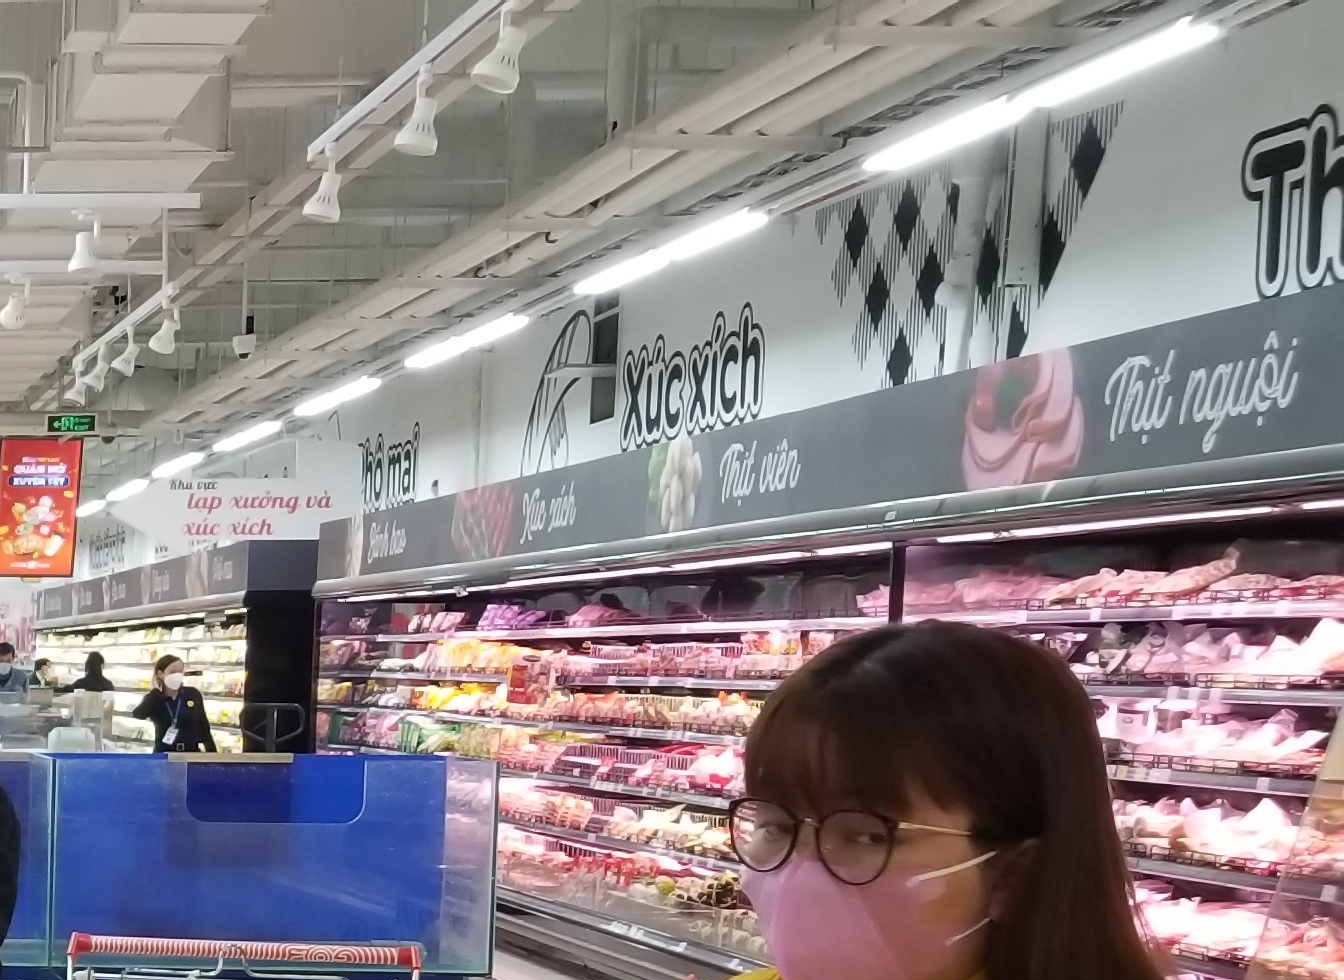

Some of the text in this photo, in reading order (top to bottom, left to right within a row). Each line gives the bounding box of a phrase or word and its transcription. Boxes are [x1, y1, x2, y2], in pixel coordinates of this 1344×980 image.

[620, 302, 765, 452] Xúc xích
[1104, 331, 1299, 454] Thịt nguội
[168, 478, 193, 491] Khu
[187, 492, 222, 515] lạp
[305, 490, 333, 509] và
[358, 432, 384, 513] hô
[719, 438, 802, 506] Thịt viên
[182, 517, 275, 536] xúc xích
